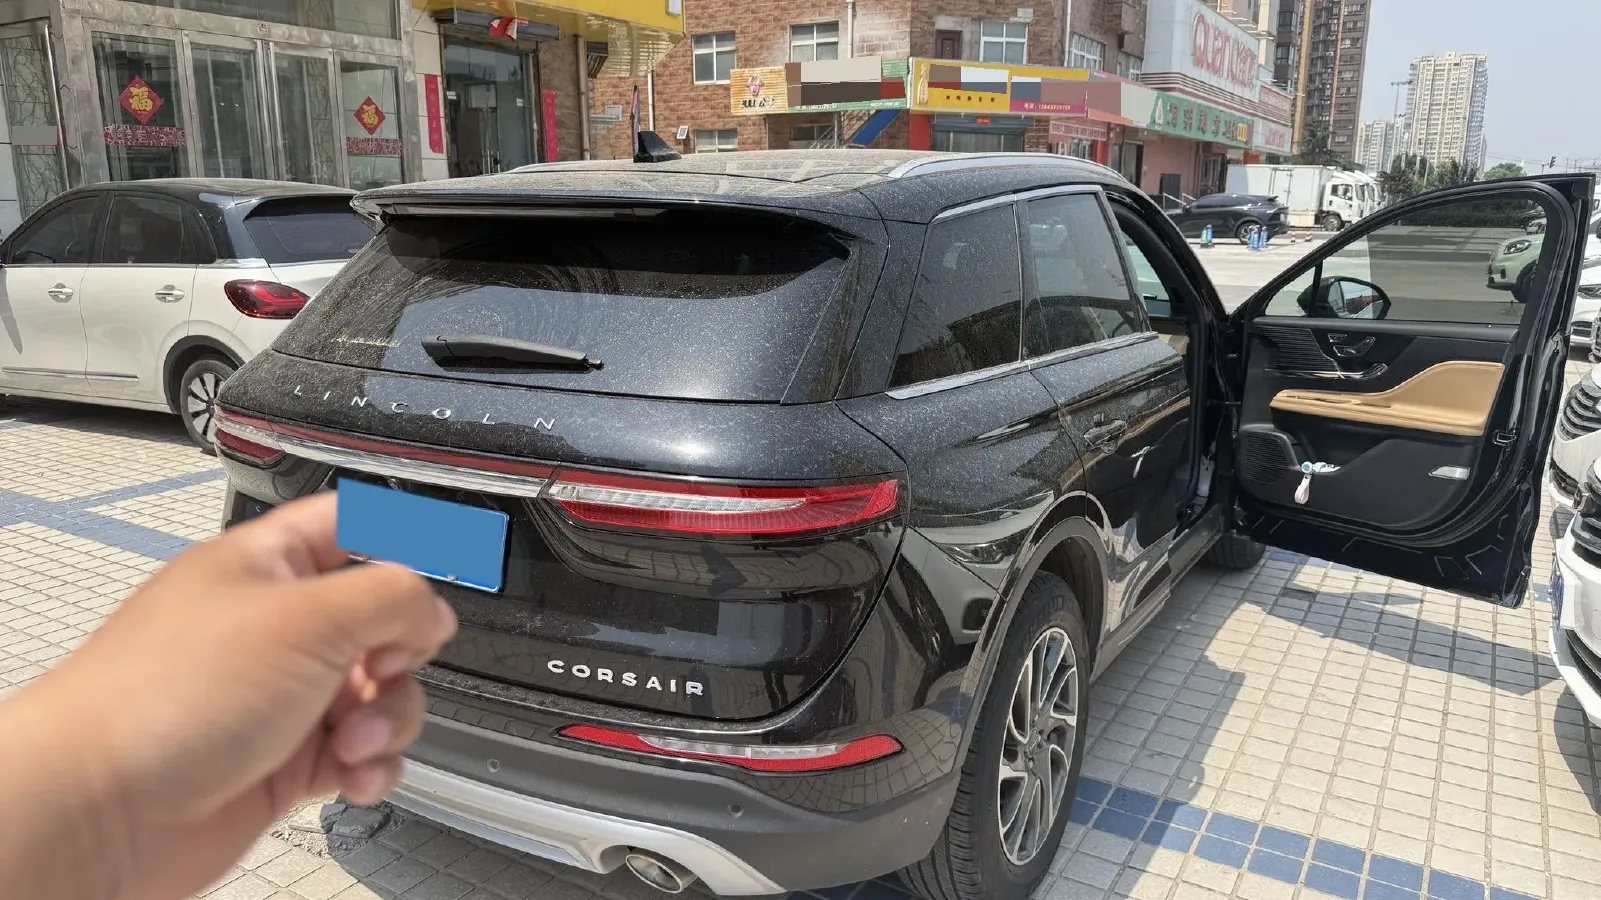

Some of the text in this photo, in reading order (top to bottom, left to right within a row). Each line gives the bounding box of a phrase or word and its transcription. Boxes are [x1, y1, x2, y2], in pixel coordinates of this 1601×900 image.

[129, 86, 153, 111] 福
[361, 104, 379, 126] 福
[293, 385, 556, 431] LINCOLN
[547, 659, 704, 696] CORSAIR
